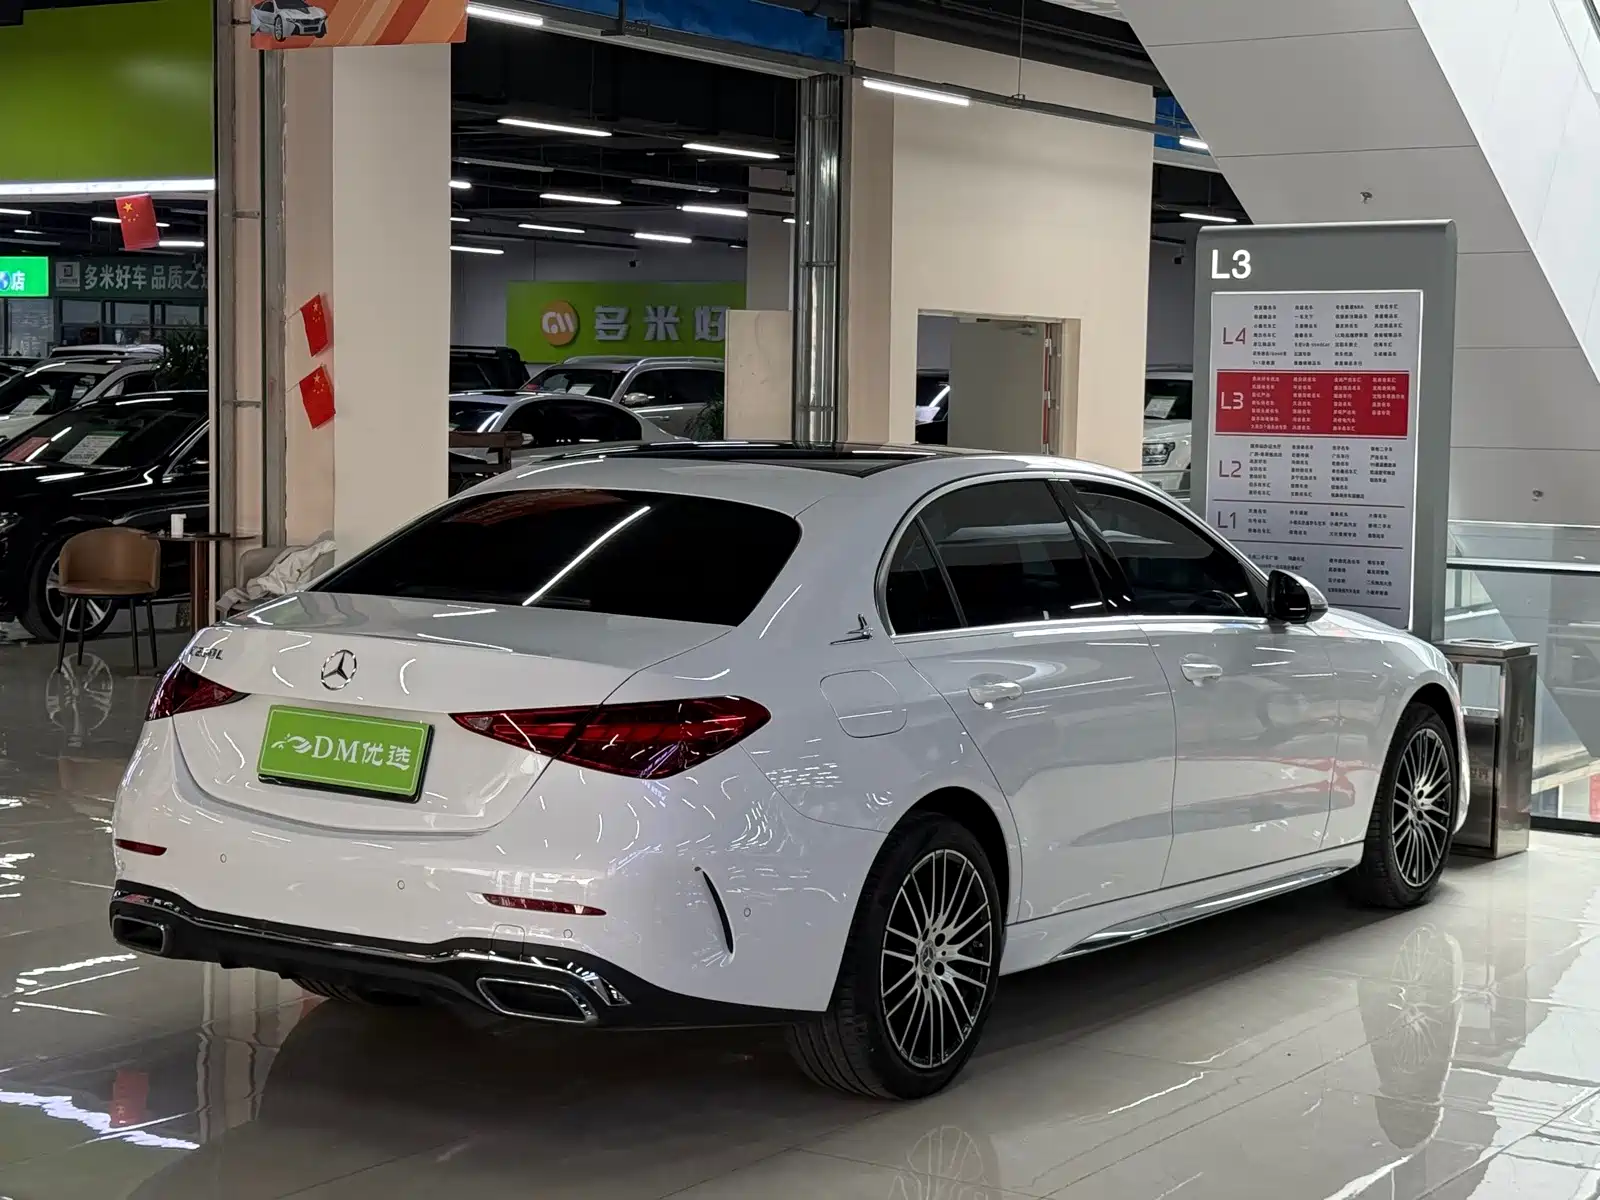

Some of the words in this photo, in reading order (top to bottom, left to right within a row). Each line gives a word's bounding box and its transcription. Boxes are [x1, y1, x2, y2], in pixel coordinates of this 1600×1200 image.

[1211, 249, 1252, 280] L3
[11, 271, 25, 291] 店
[84, 264, 148, 290] 多米好车
[594, 305, 726, 342] 多米好
[1222, 327, 1246, 345] L4
[1221, 391, 1244, 410] L3
[1219, 460, 1242, 478] L2
[1217, 511, 1237, 529] L1
[311, 735, 412, 771] DM优选
